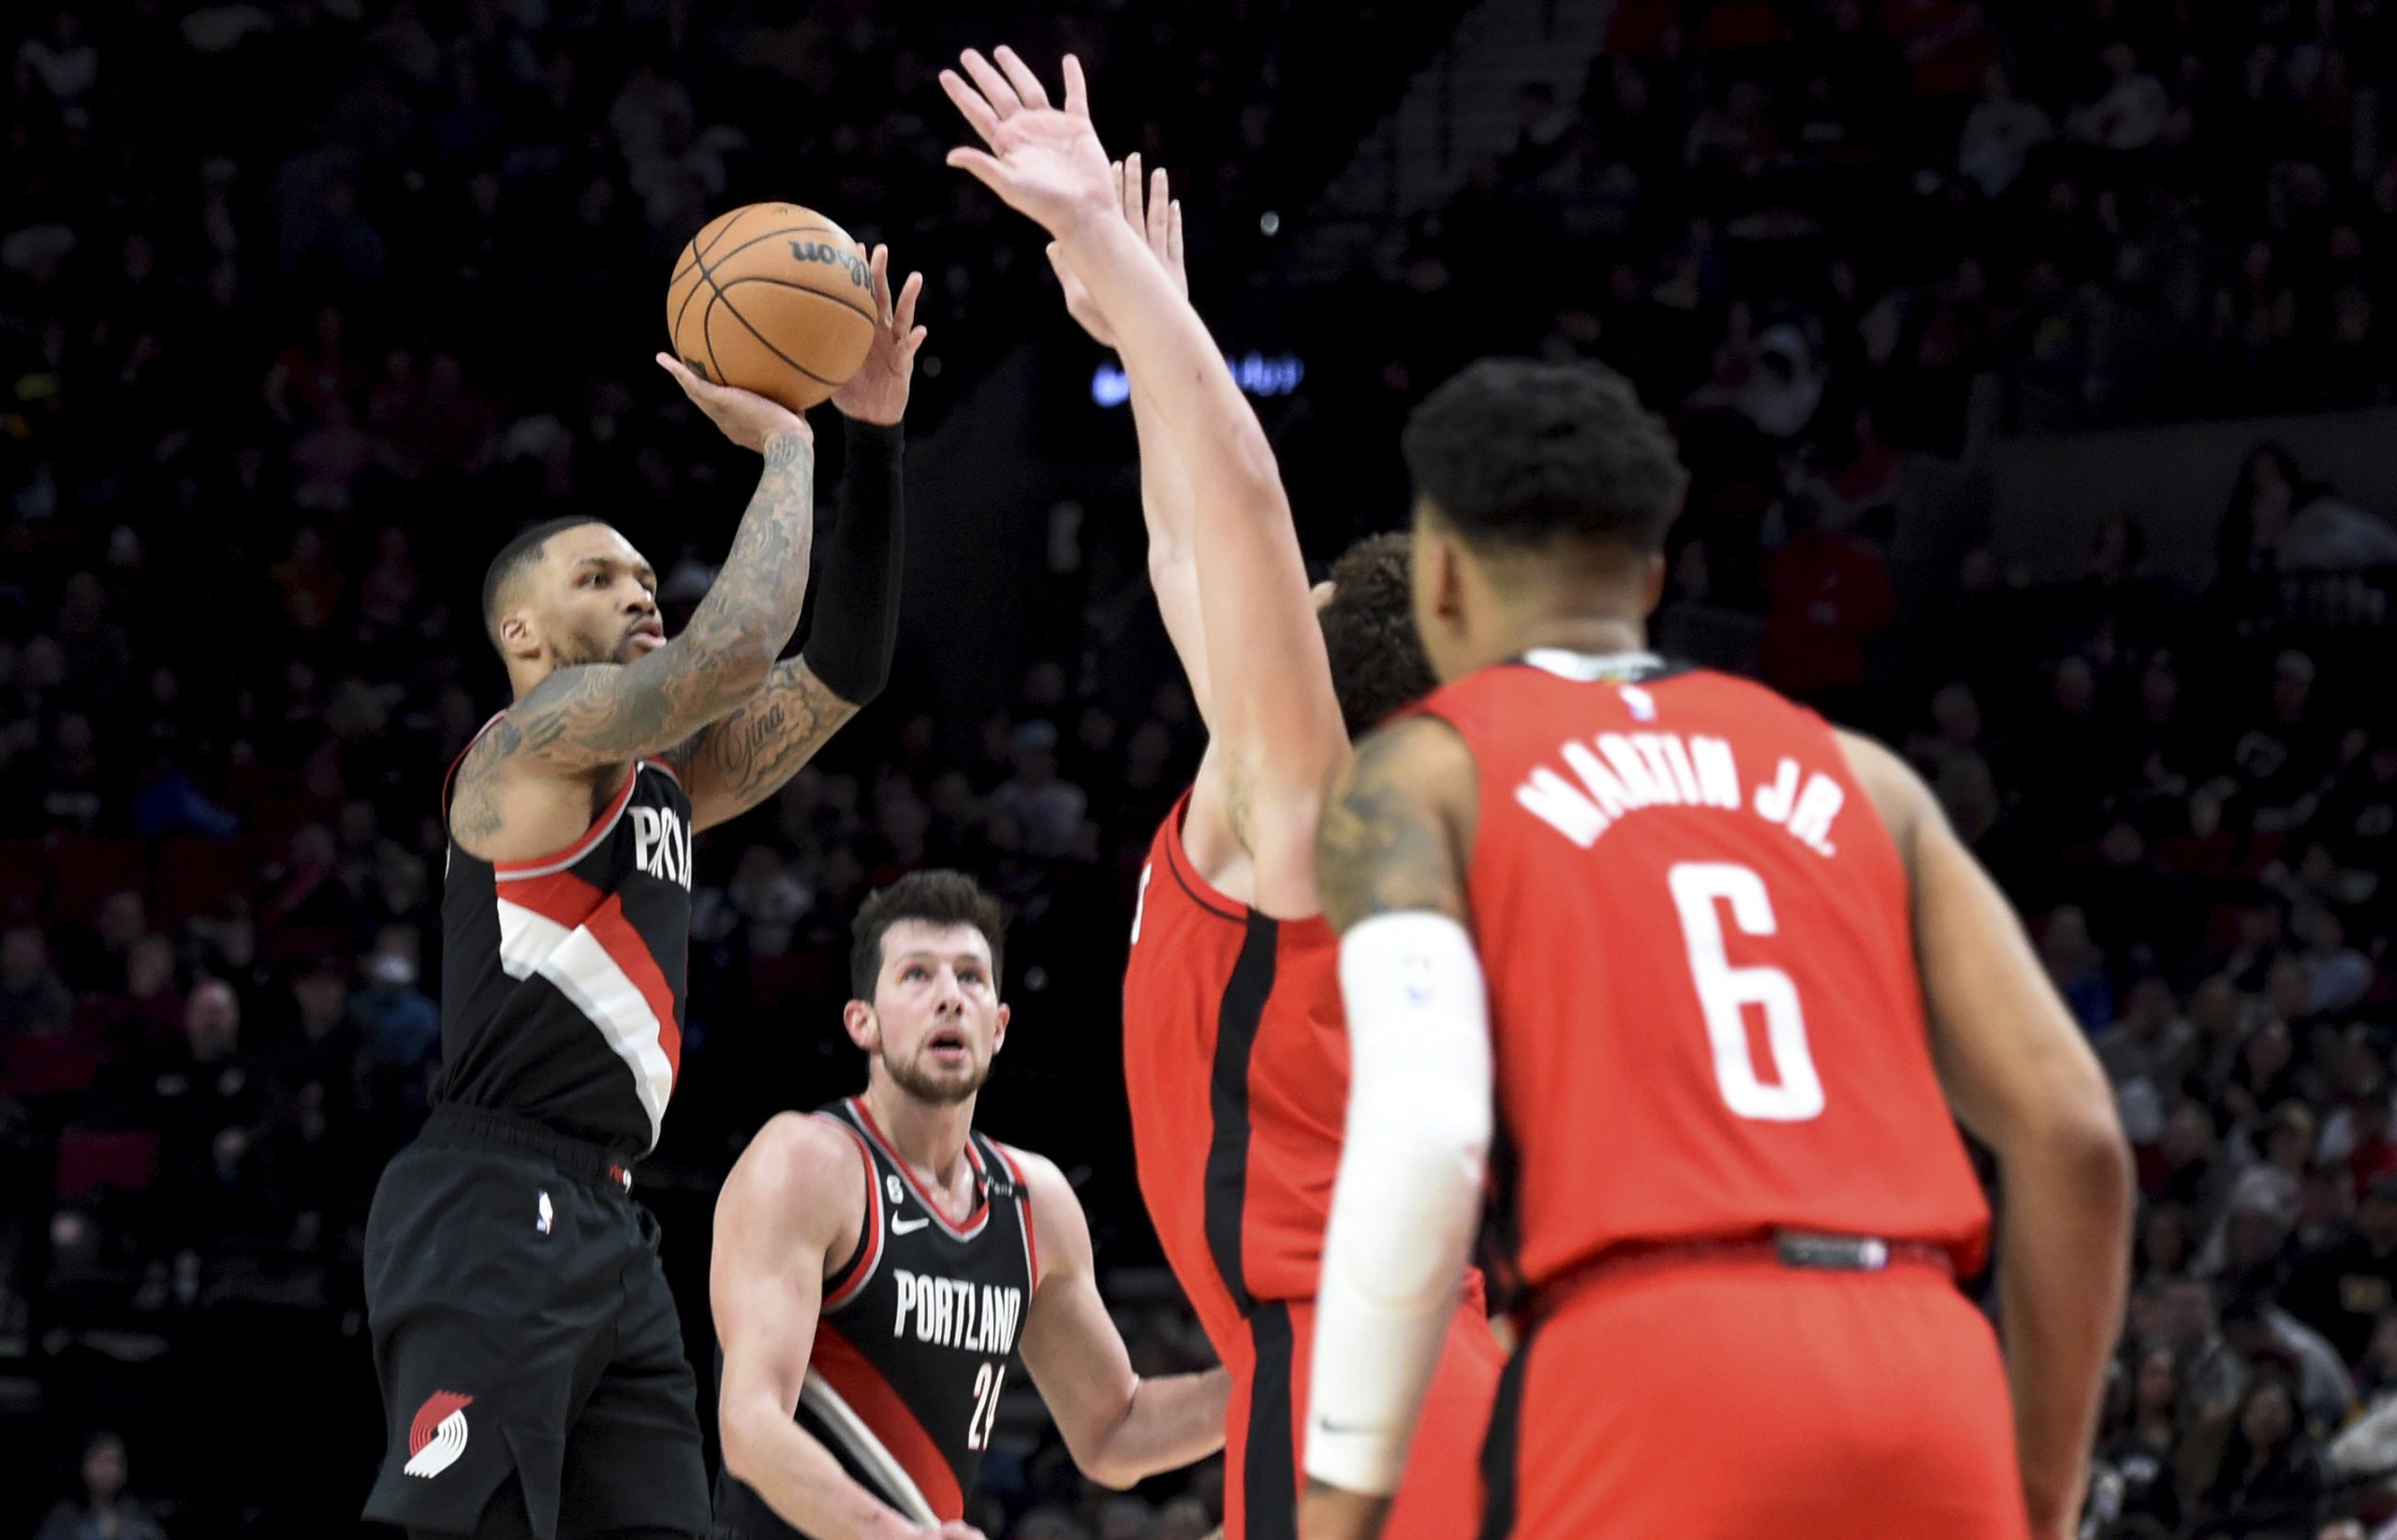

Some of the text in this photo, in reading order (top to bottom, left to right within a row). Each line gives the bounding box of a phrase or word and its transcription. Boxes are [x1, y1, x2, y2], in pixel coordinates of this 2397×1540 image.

[1515, 732, 1845, 857] MARTIN JR.
[1668, 860, 1825, 1121] 6
[892, 1268, 1022, 1356] PORTLAND
